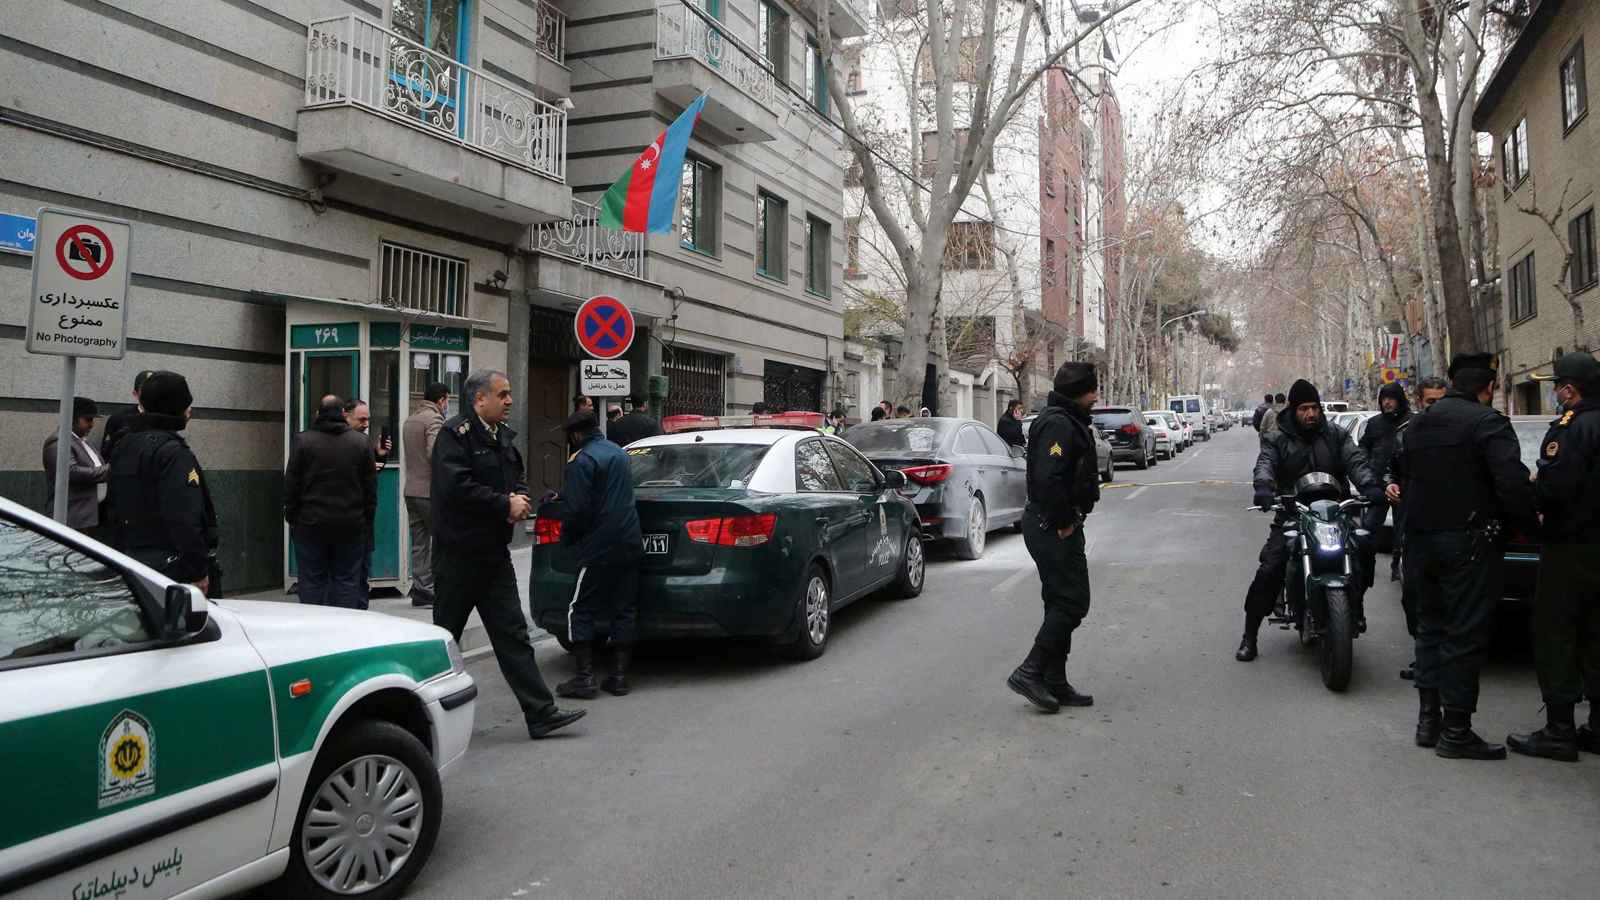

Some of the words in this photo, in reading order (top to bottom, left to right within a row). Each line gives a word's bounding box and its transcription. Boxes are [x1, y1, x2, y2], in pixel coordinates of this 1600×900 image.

[40, 292, 120, 310] عکسبرداری
[58, 314, 103, 329] ممنوع
[36, 332, 51, 342] No
[54, 333, 117, 348] Photography
[315, 328, 339, 343] ۲۶۹
[142, 847, 182, 888] پلیس
